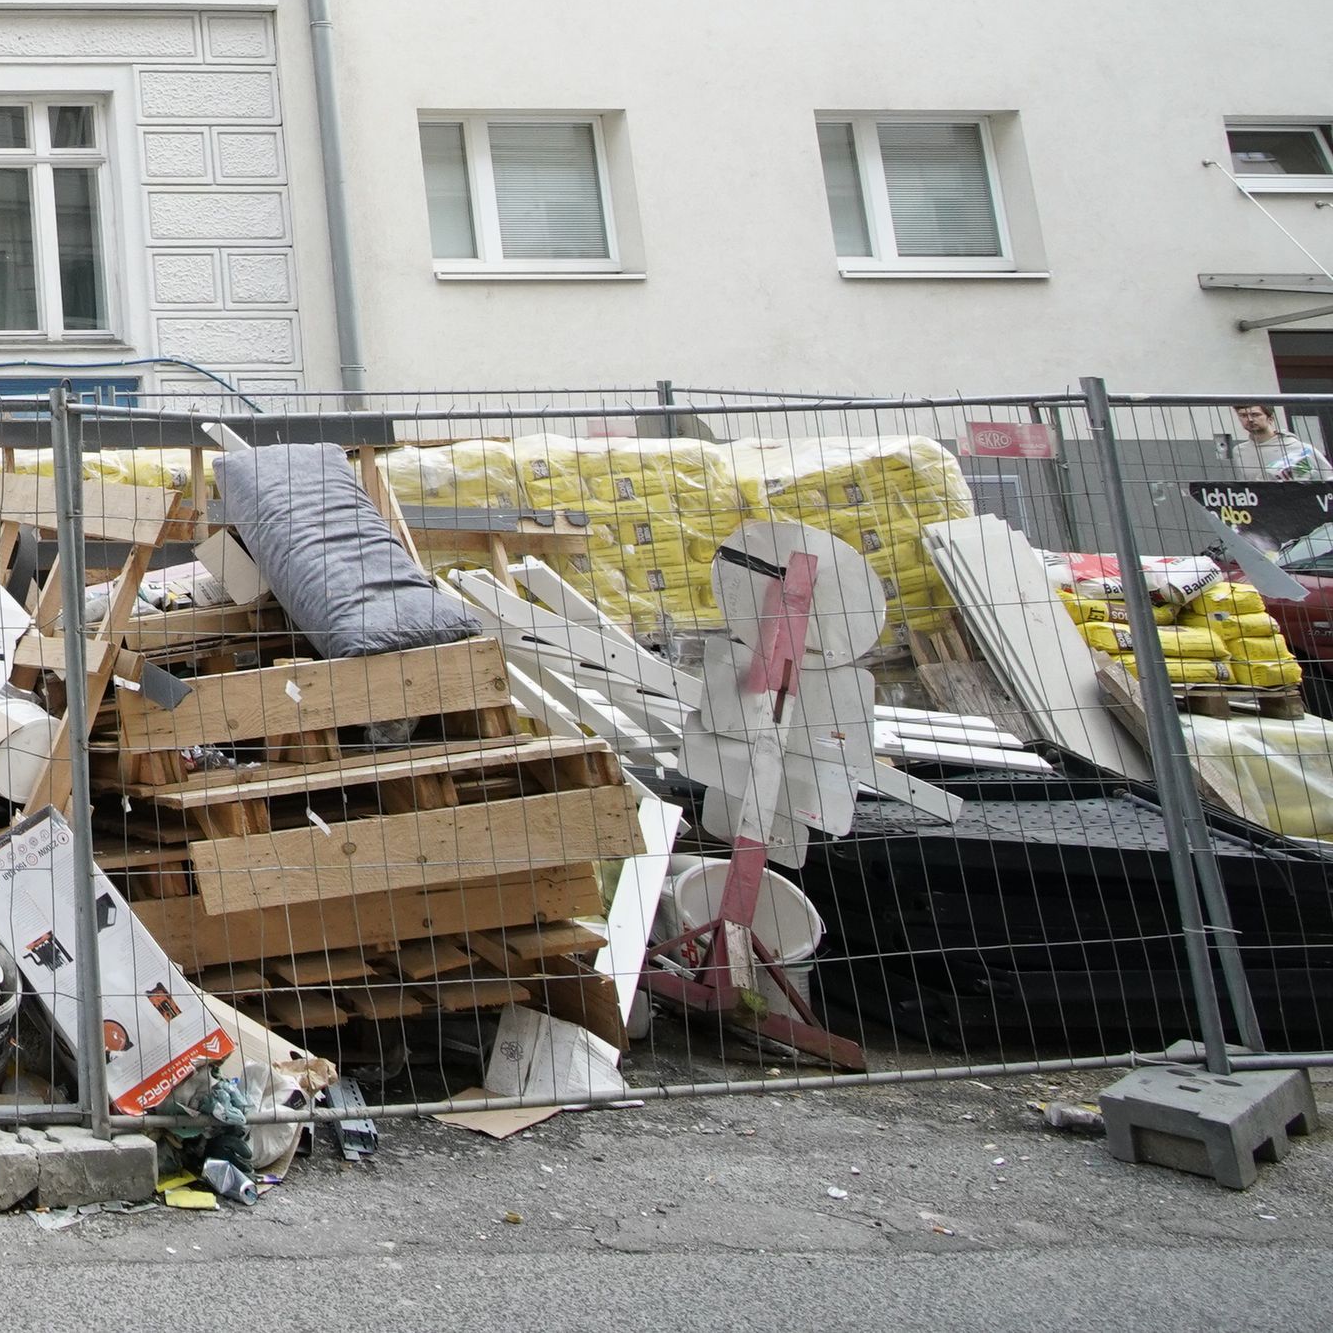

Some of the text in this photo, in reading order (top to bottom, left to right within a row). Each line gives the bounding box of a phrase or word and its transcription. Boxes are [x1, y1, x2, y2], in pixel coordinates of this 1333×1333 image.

[978, 433, 1009, 447] EKRO
[1202, 488, 1226, 506] Ich
[1228, 488, 1258, 506] hab
